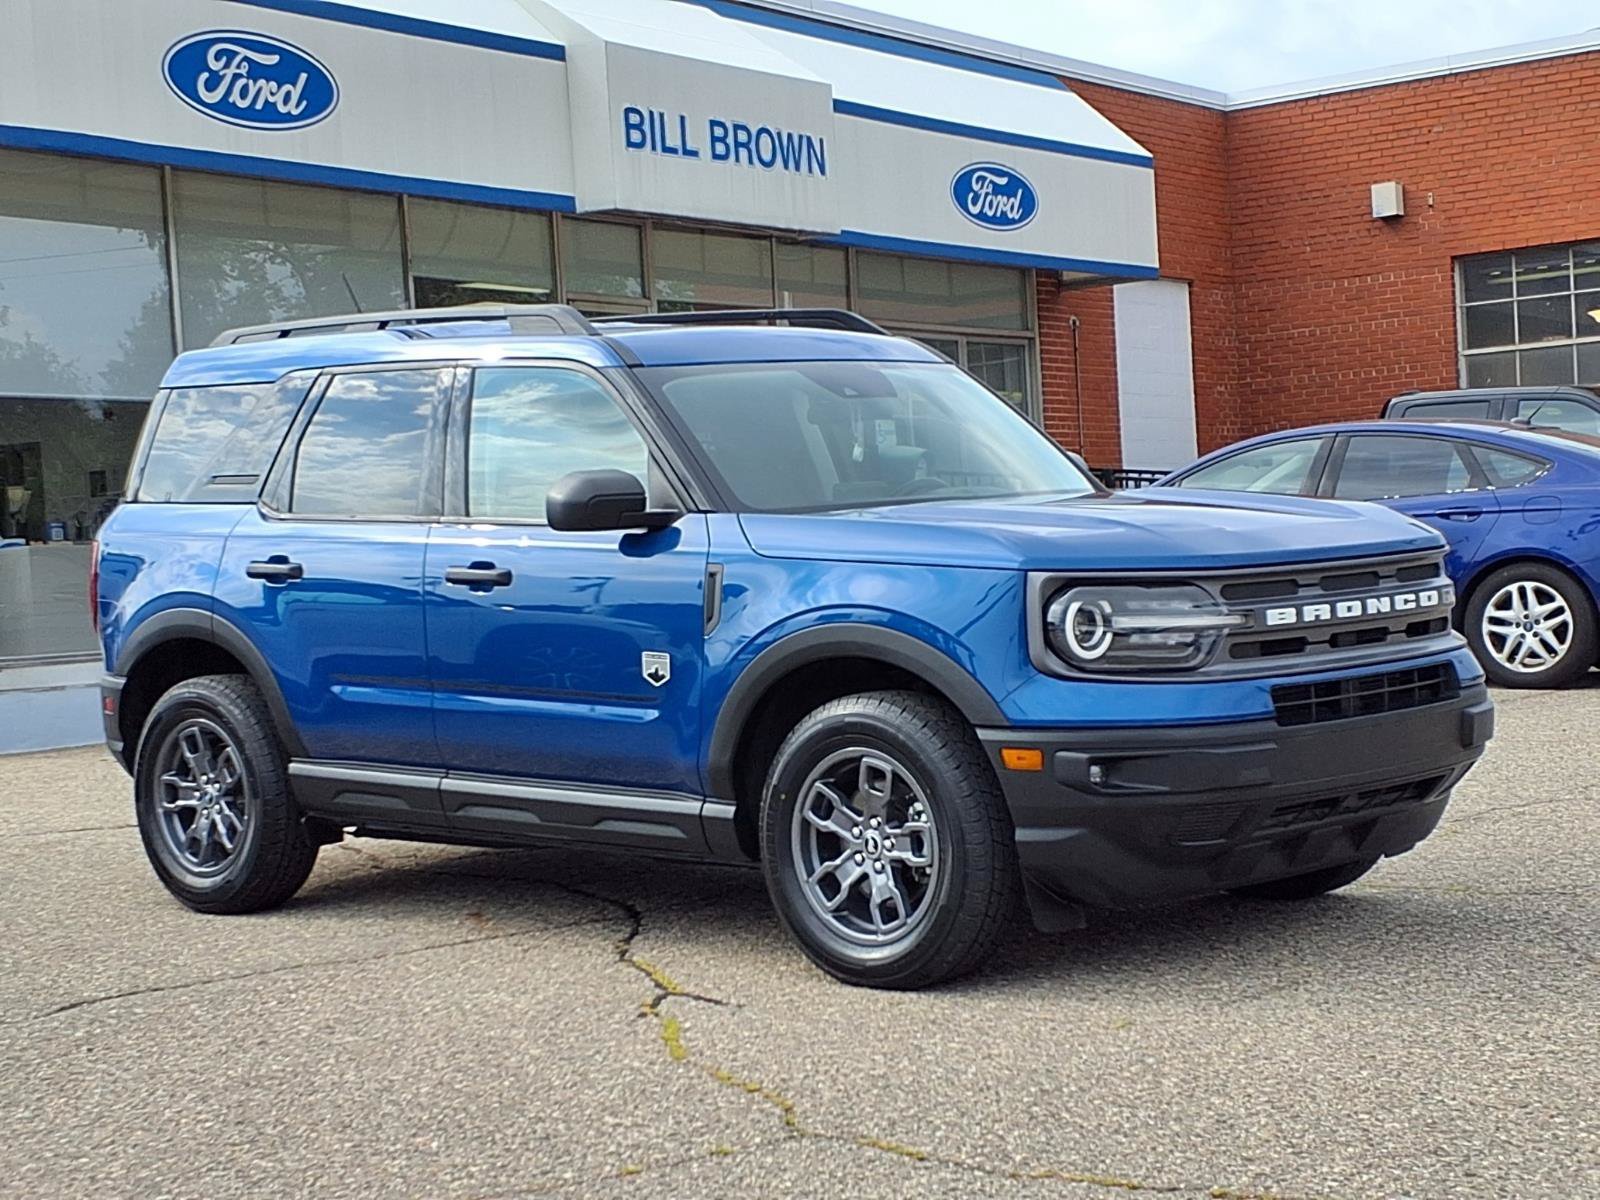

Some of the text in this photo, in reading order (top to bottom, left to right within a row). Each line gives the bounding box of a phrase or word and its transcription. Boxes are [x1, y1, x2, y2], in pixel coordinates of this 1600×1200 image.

[196, 42, 308, 115] Ford
[624, 106, 826, 176] BILL BROWN
[967, 171, 1023, 220] Ford
[1265, 590, 1439, 626] BRONCO
